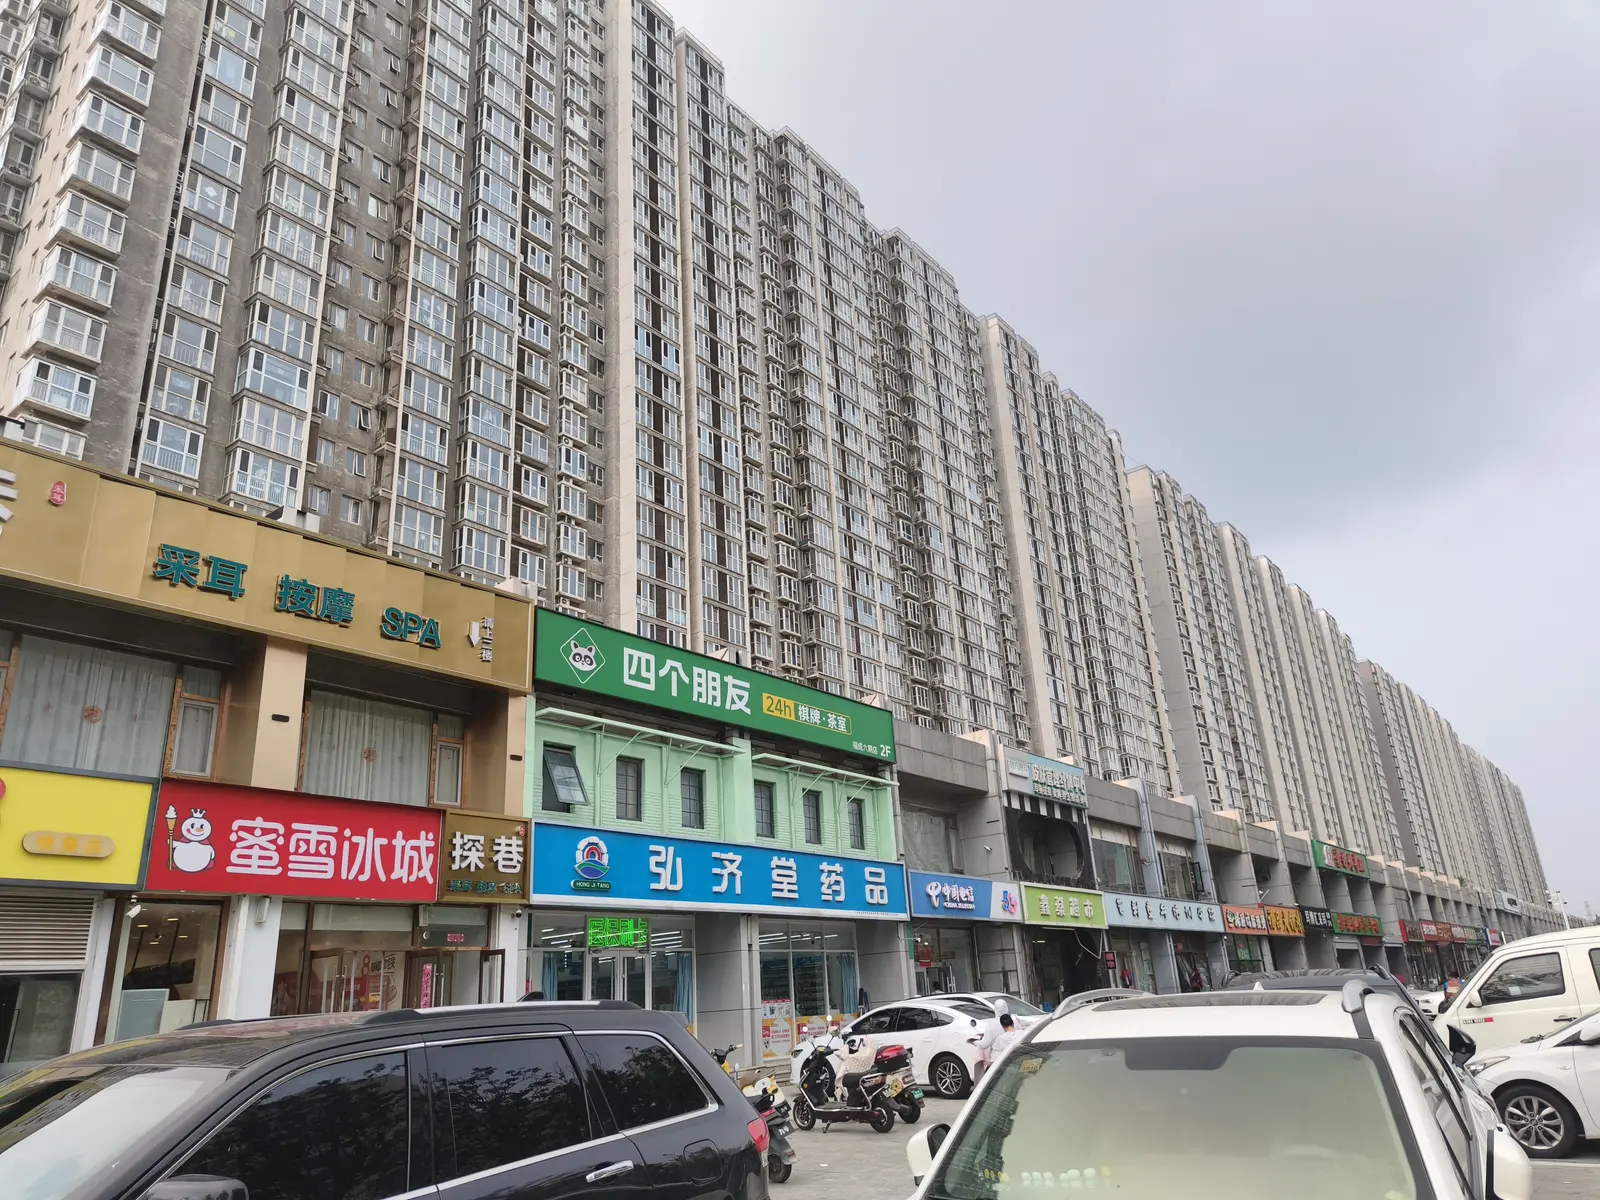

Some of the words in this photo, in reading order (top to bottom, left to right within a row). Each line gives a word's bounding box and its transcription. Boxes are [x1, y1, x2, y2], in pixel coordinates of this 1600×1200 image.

[154, 543, 248, 599] 采耳
[275, 574, 357, 627] 按摩
[381, 606, 442, 650] SPA
[623, 647, 752, 715] 四个朋友
[766, 695, 793, 718] 24h
[880, 744, 891, 757] 2F
[225, 815, 435, 885] 蜜雪冰城
[451, 831, 524, 874] 探巷
[503, 882, 522, 894] SPA
[648, 844, 888, 905] 弘济堂药品
[942, 884, 974, 903] 中国电信
